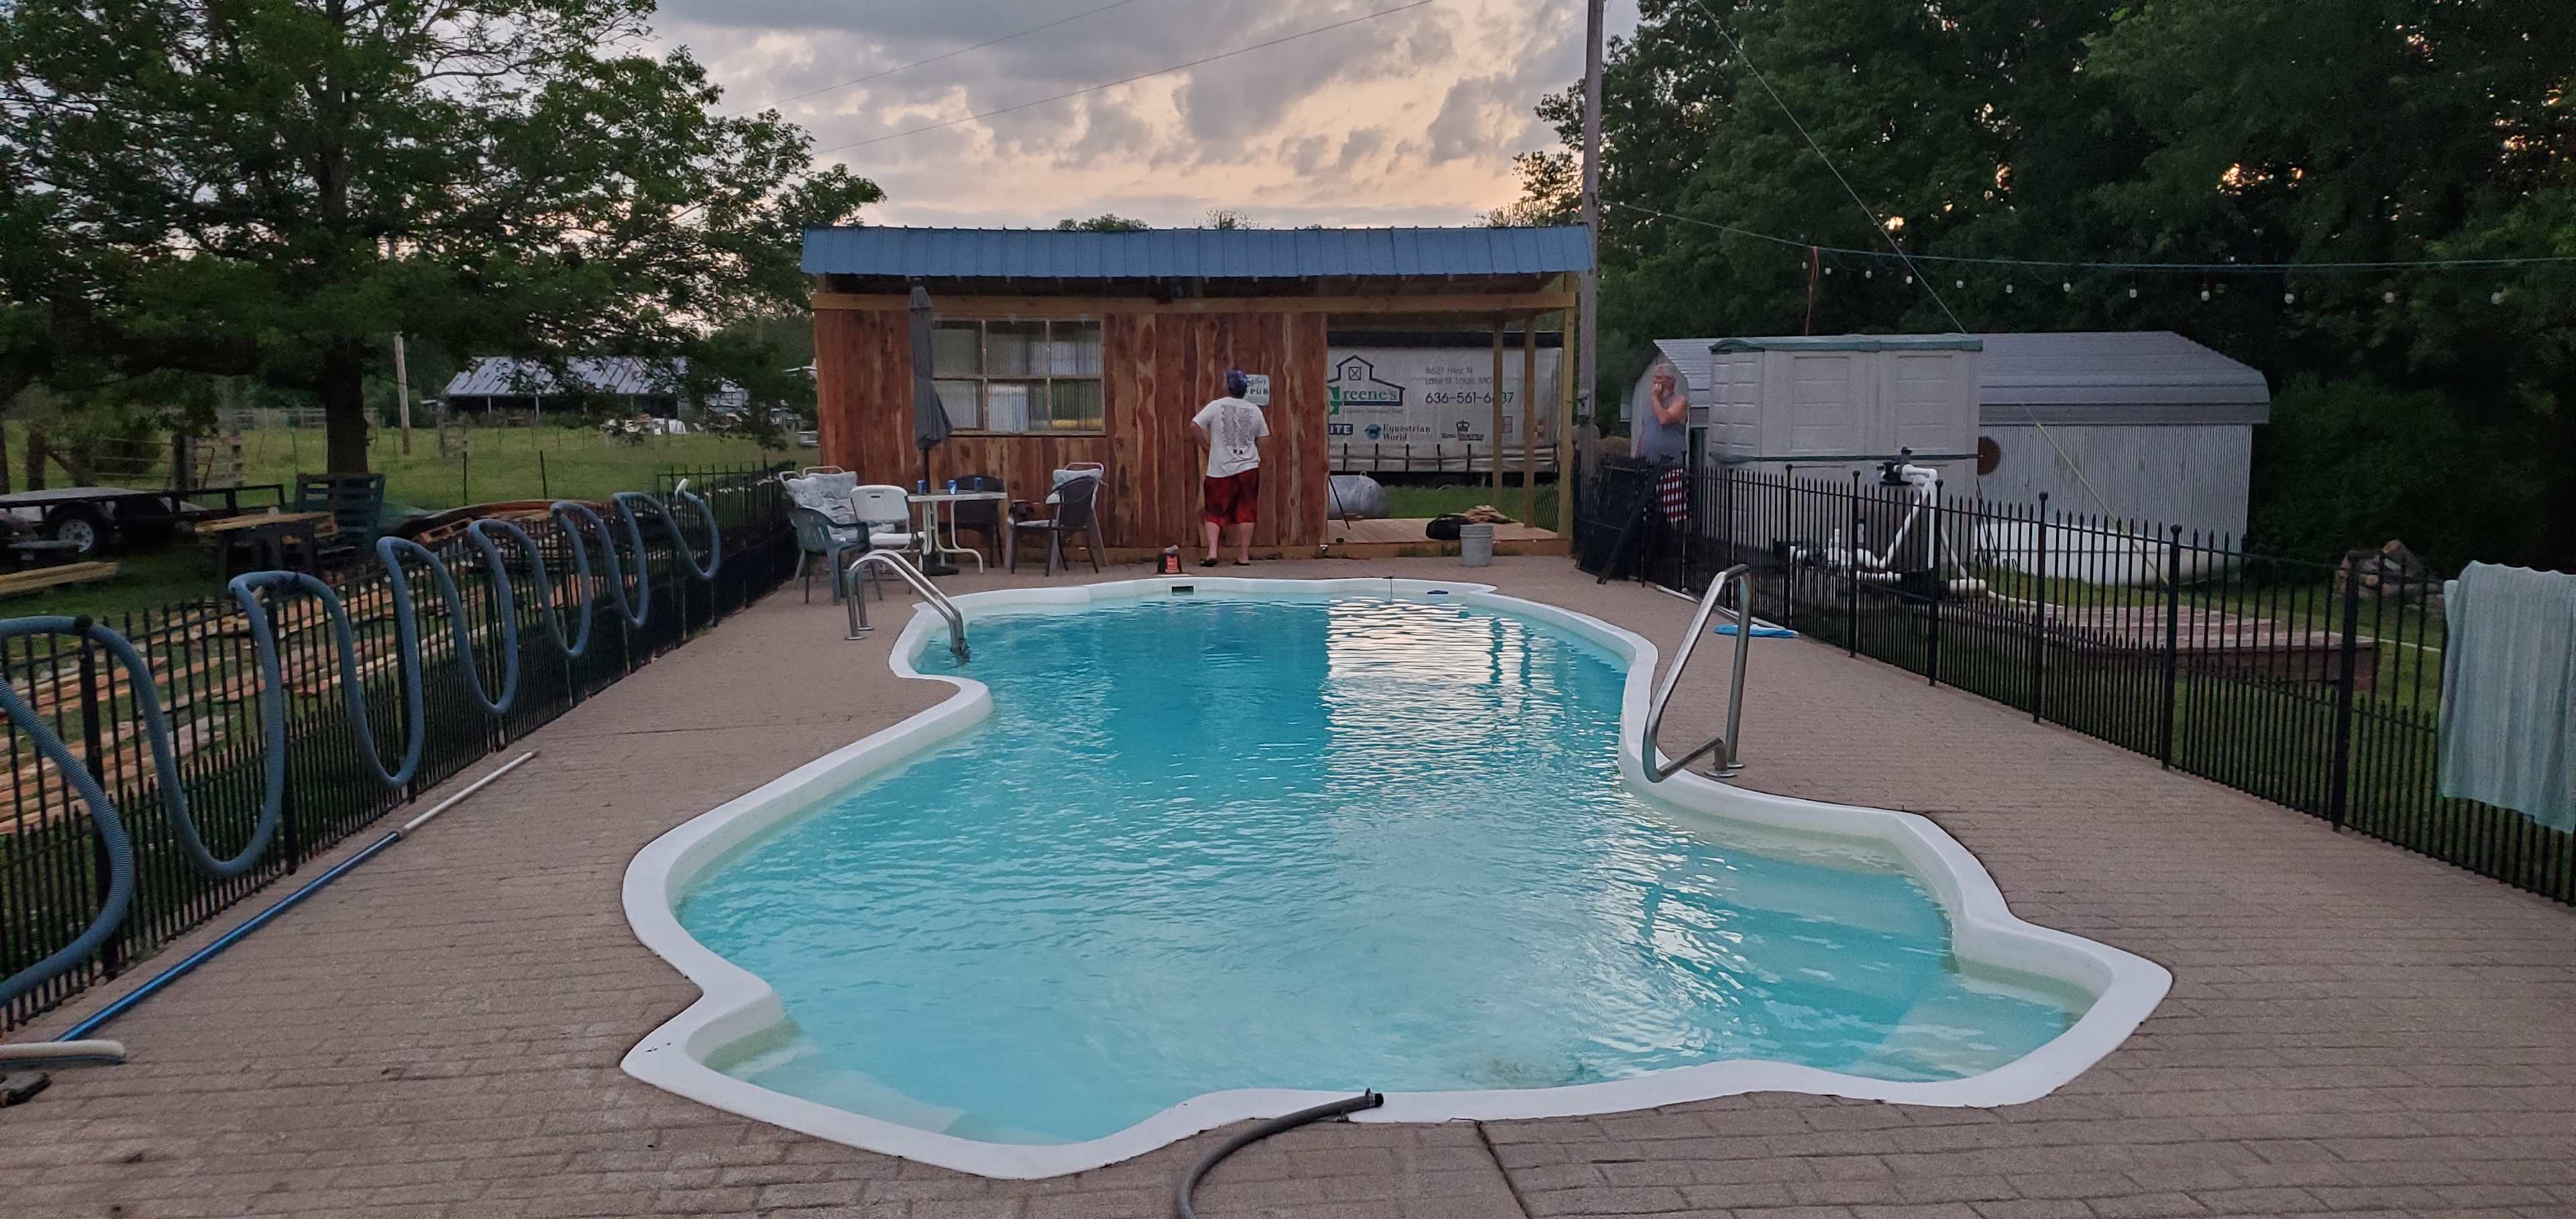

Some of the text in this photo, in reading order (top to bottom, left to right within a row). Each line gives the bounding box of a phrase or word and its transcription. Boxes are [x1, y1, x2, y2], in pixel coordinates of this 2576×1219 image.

[1425, 392, 1514, 404] 636-561-637
[1383, 424, 1431, 434] Equestrian
[1383, 433, 1408, 441] World
